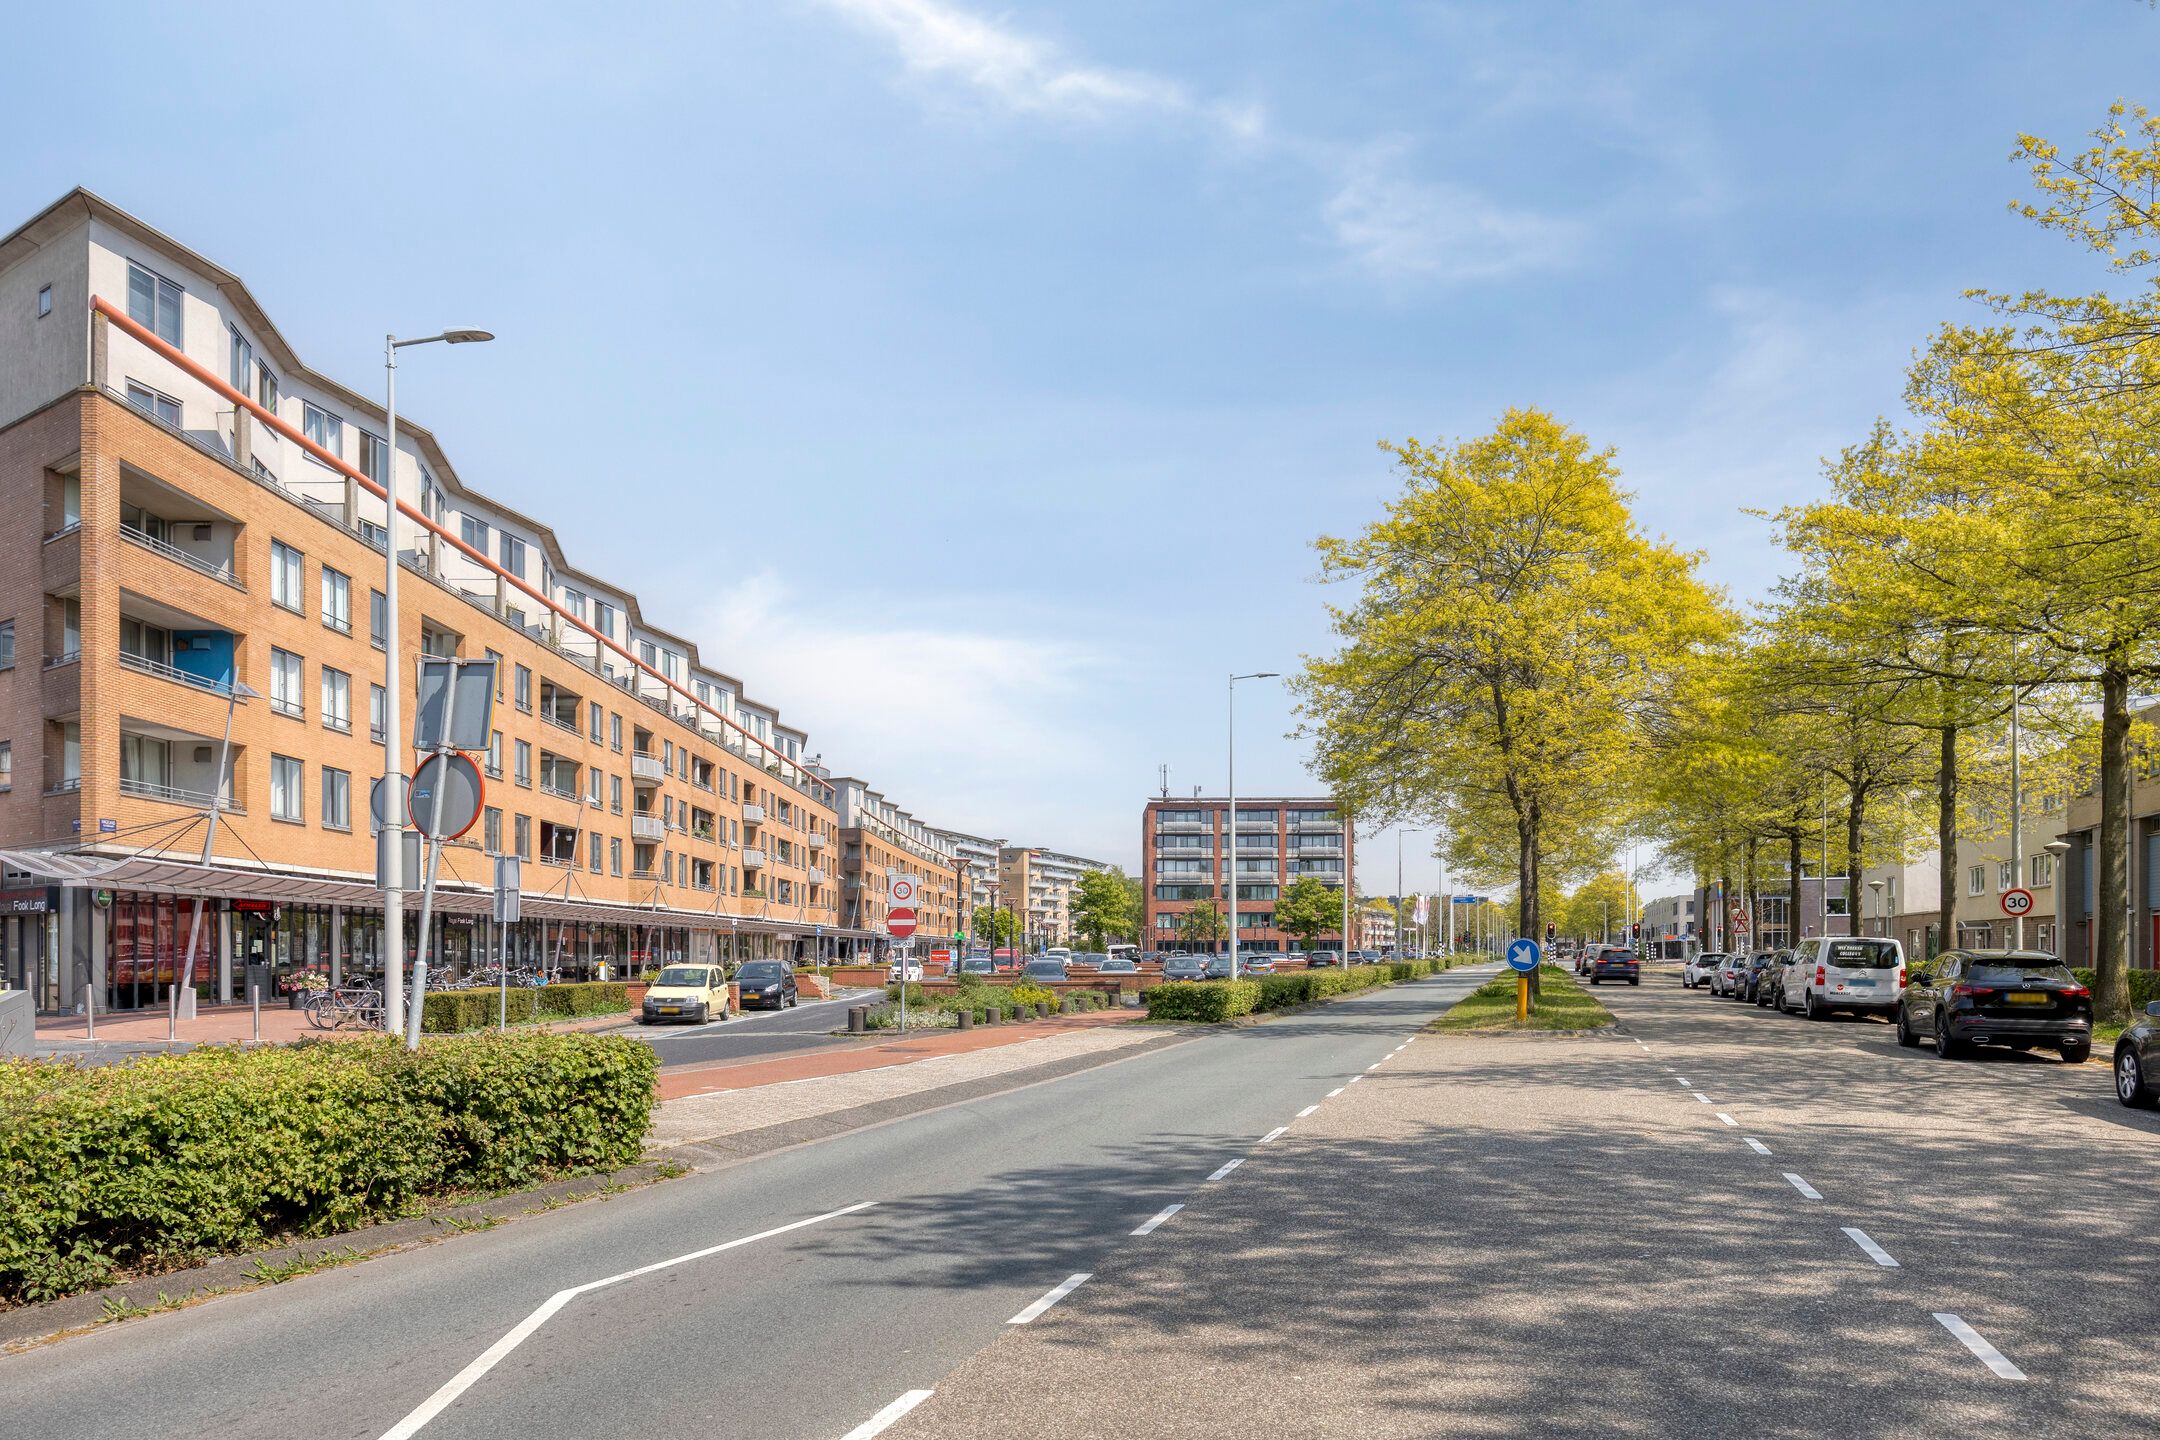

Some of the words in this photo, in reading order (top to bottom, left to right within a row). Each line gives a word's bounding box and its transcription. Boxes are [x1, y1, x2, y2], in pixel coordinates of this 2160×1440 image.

[13, 900, 29, 911] Fook
[30, 900, 46, 912] Long
[2007, 897, 2028, 908] 30
